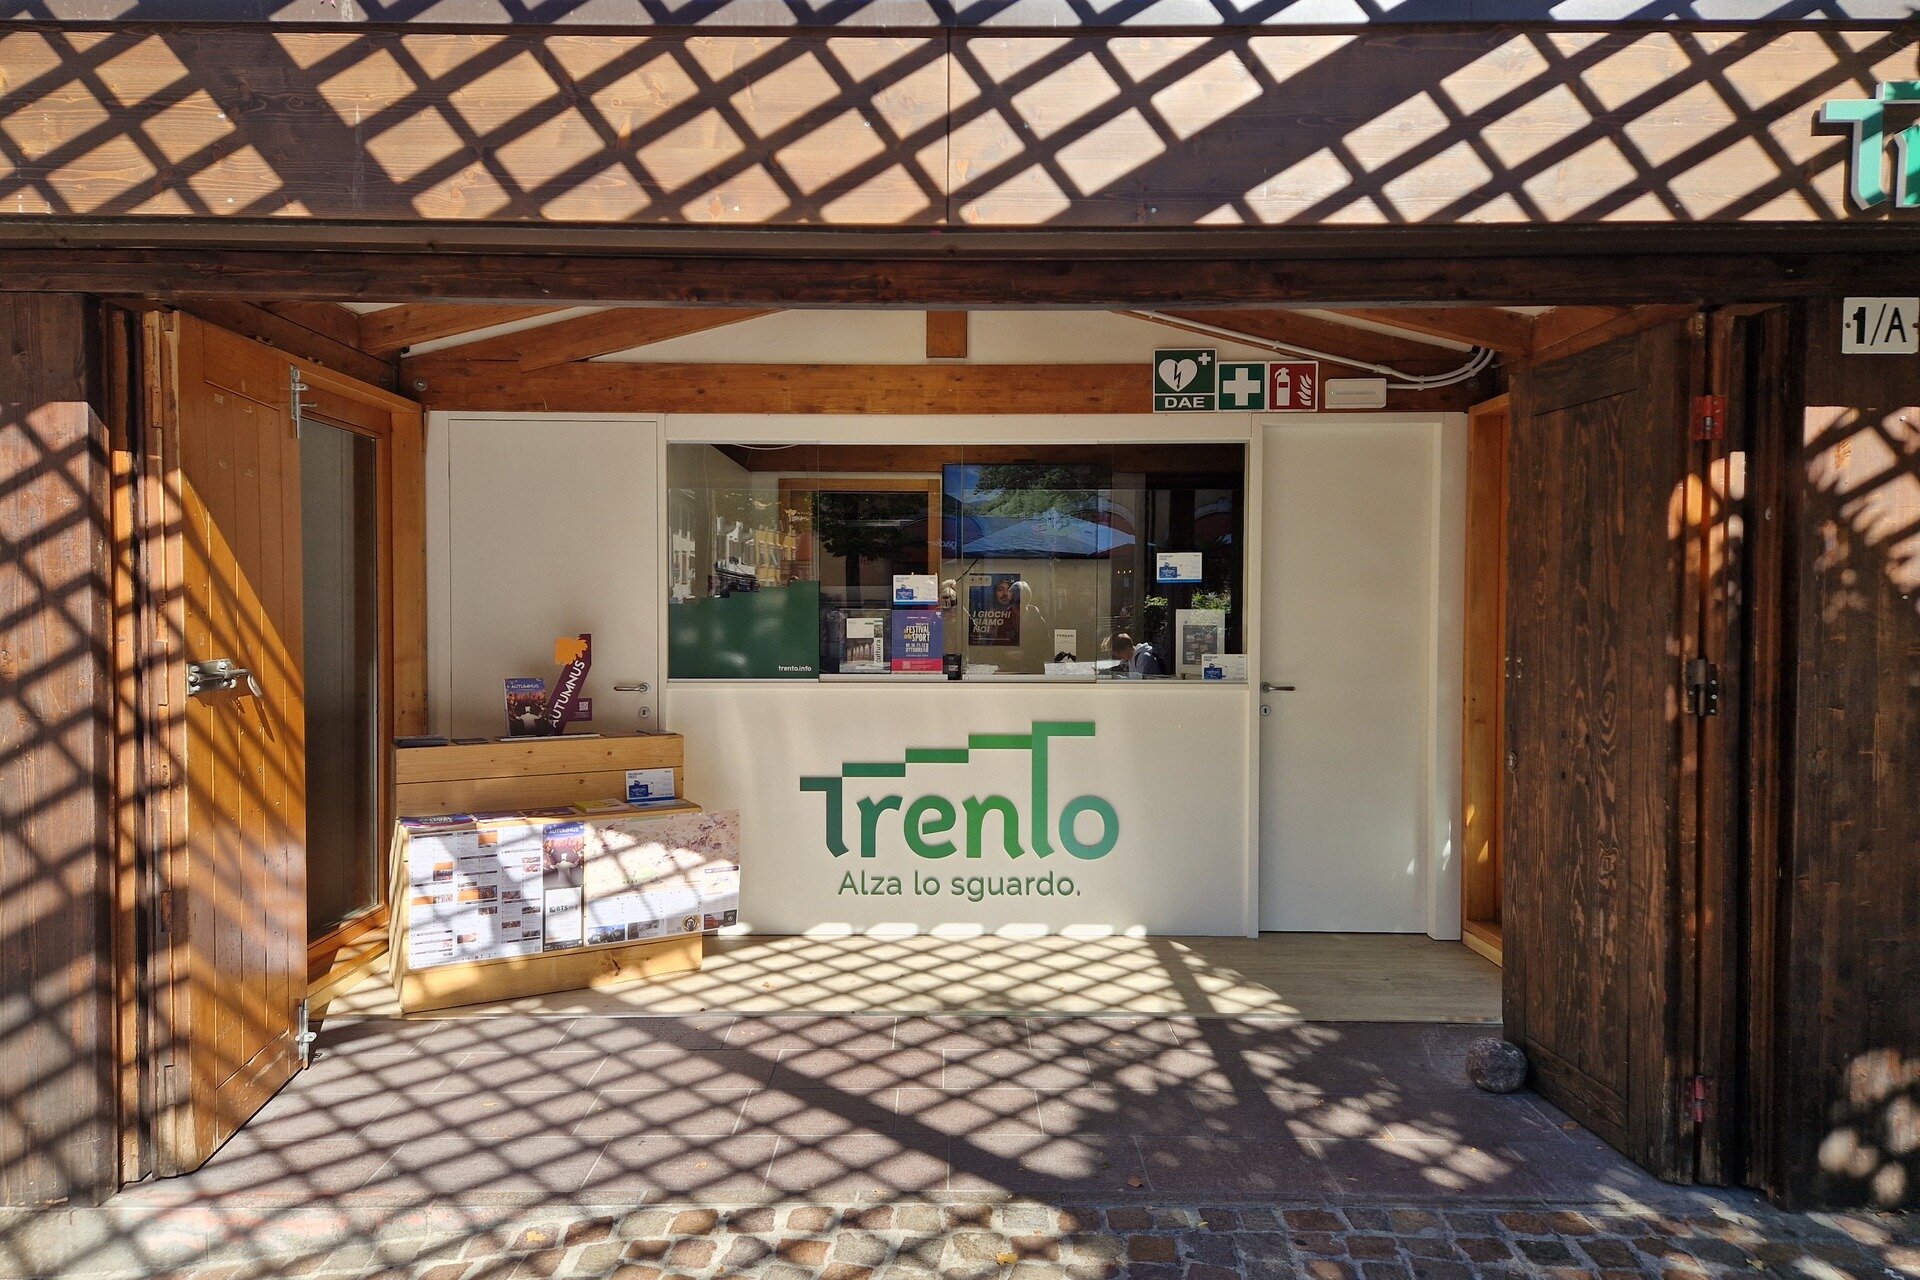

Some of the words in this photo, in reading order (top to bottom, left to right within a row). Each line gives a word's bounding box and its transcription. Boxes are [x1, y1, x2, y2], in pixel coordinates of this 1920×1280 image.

[1852, 303, 1907, 346] 1/A
[1164, 396, 1206, 410] DAE
[906, 625, 930, 633] FESTIVAL
[912, 633, 930, 641] SPORT
[548, 660, 586, 728] AUTUMNUS
[800, 721, 1119, 861] Trento
[838, 870, 902, 896] Alza
[914, 870, 941, 896] lo
[951, 870, 1081, 902] sguardo.
